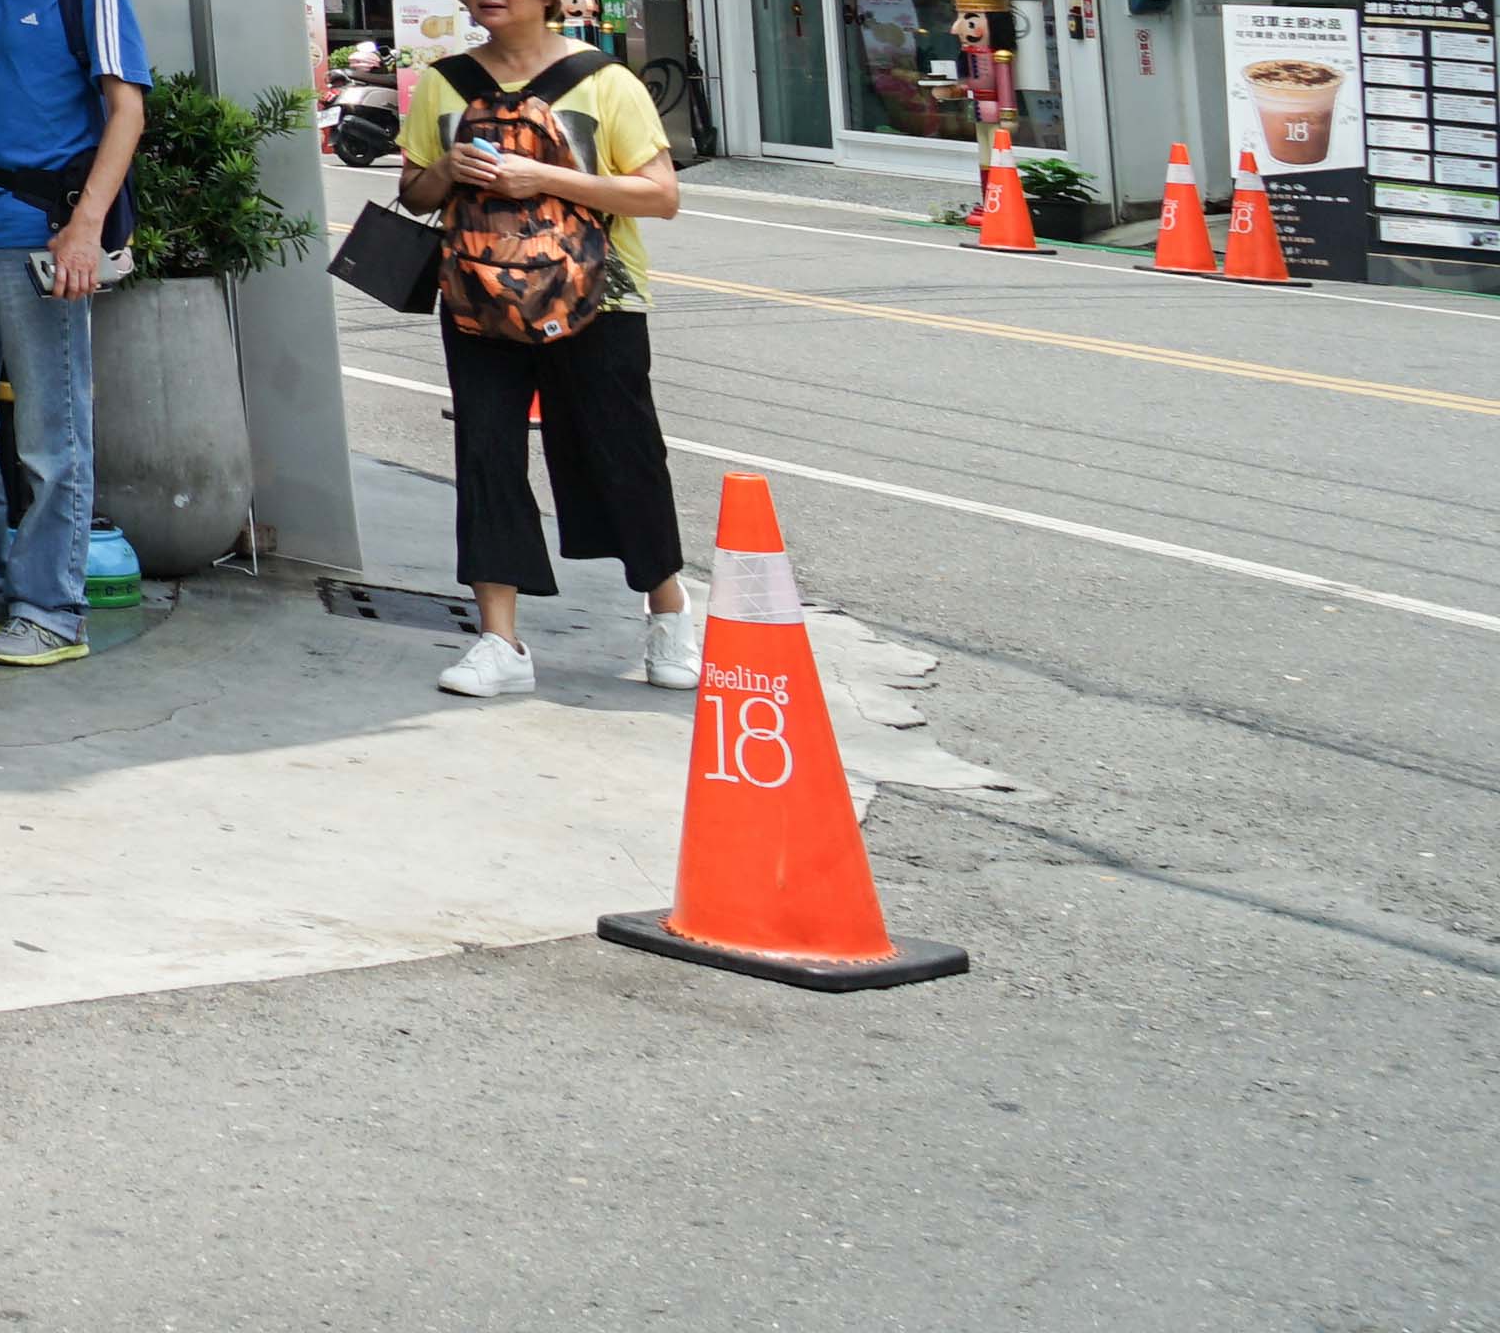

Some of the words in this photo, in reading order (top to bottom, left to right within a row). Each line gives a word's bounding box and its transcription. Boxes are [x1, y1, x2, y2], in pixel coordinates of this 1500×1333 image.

[1252, 15, 1342, 29] 冠軍主廚冰品
[1284, 121, 1308, 141] 18
[1229, 207, 1253, 233] 18
[703, 662, 789, 698] Feeling
[703, 694, 793, 789] 18
